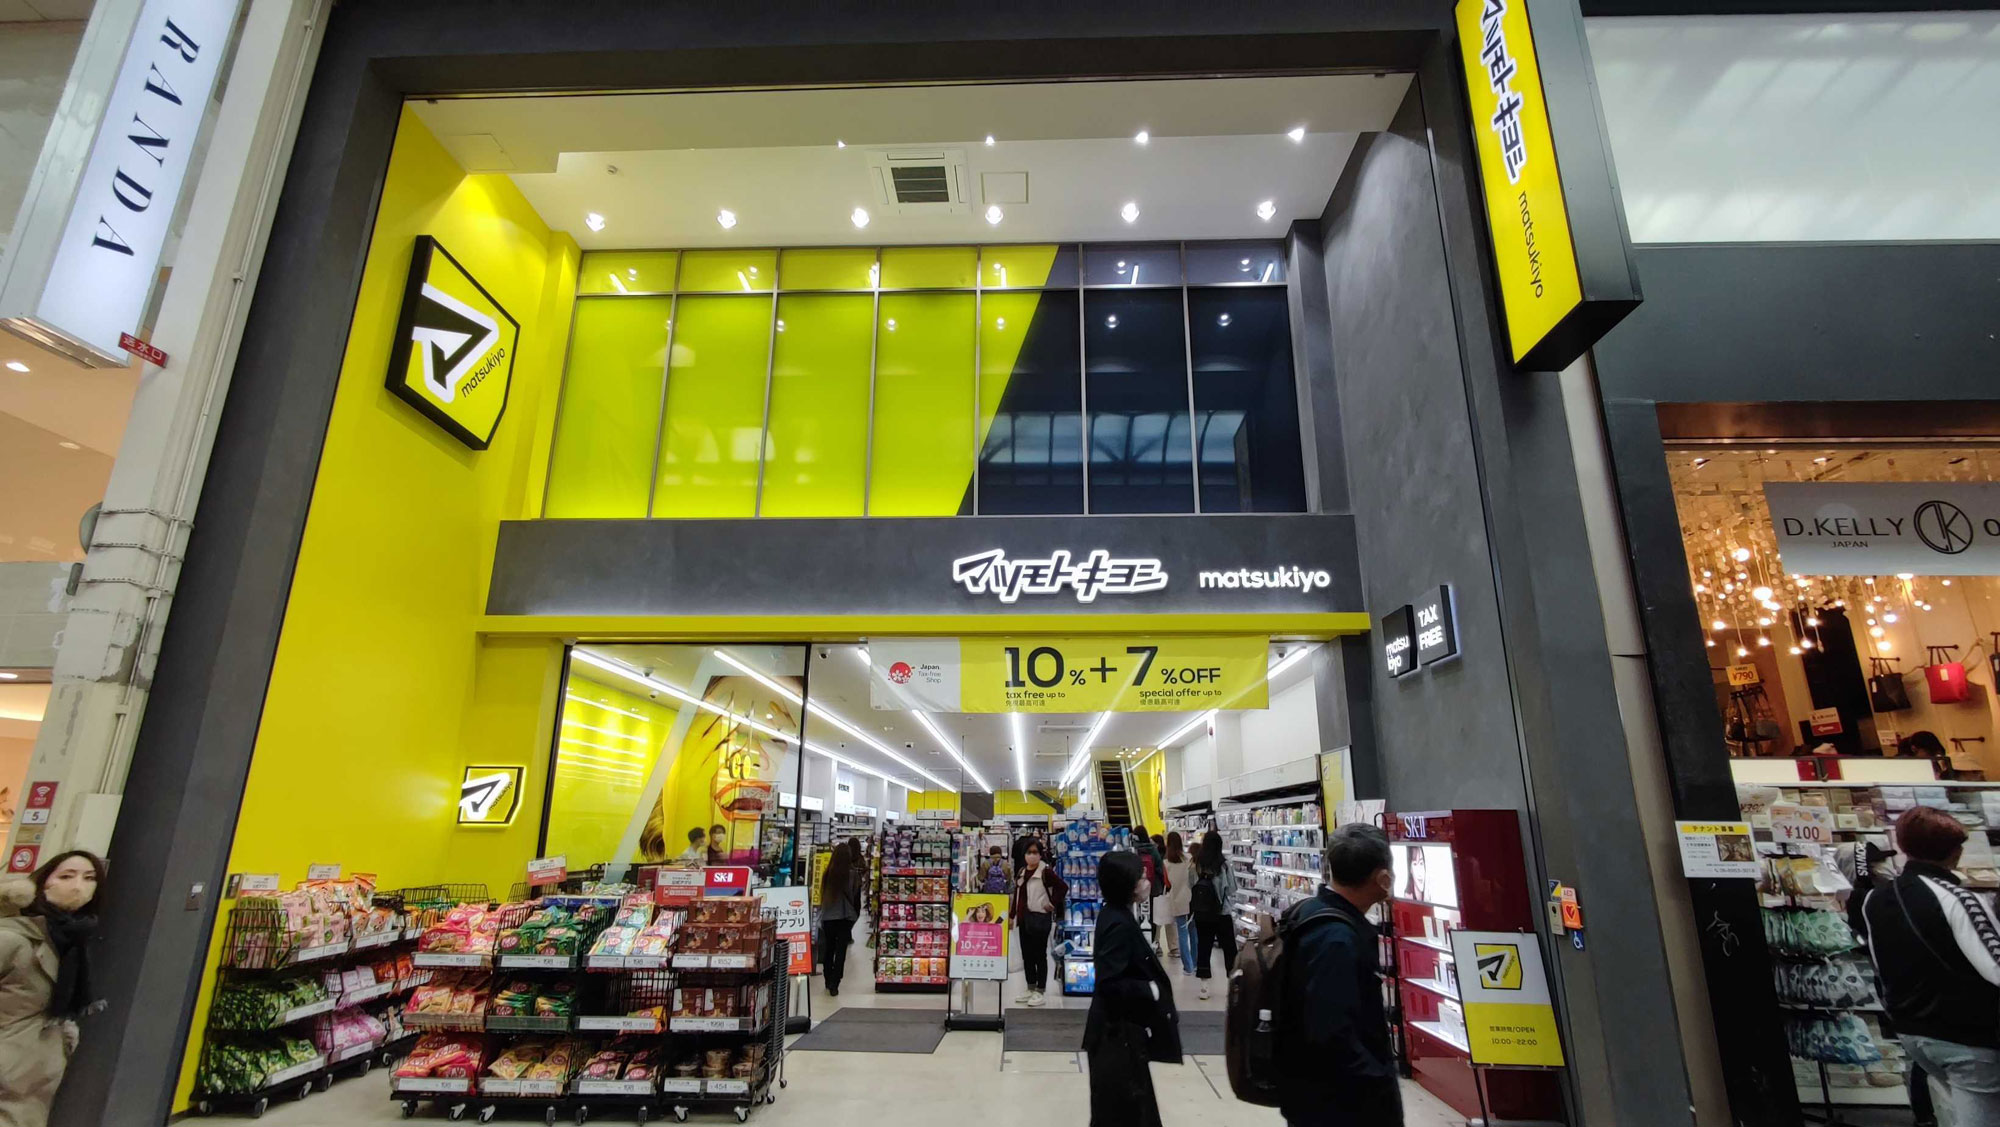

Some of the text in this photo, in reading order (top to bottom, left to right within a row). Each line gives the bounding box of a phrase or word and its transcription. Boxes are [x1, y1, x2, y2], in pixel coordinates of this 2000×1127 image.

[92, 16, 200, 256] RANDA
[1518, 190, 1543, 298] matsukiyo
[461, 347, 506, 398] matsukiyo
[1783, 517, 1904, 536] D.KELLY
[953, 549, 1168, 603] マツモトキヨシ
[1199, 566, 1331, 593] matsukiyo
[1417, 603, 1438, 628] TAX
[1385, 635, 1410, 654] matsu
[1419, 625, 1444, 651] FREE
[1006, 691, 1022, 699] tax
[1024, 690, 1045, 699] free
[1139, 688, 1174, 698] special
[1175, 688, 1202, 697] offer
[31, 811, 40, 821] 5
[1784, 825, 1820, 840] ¥100
